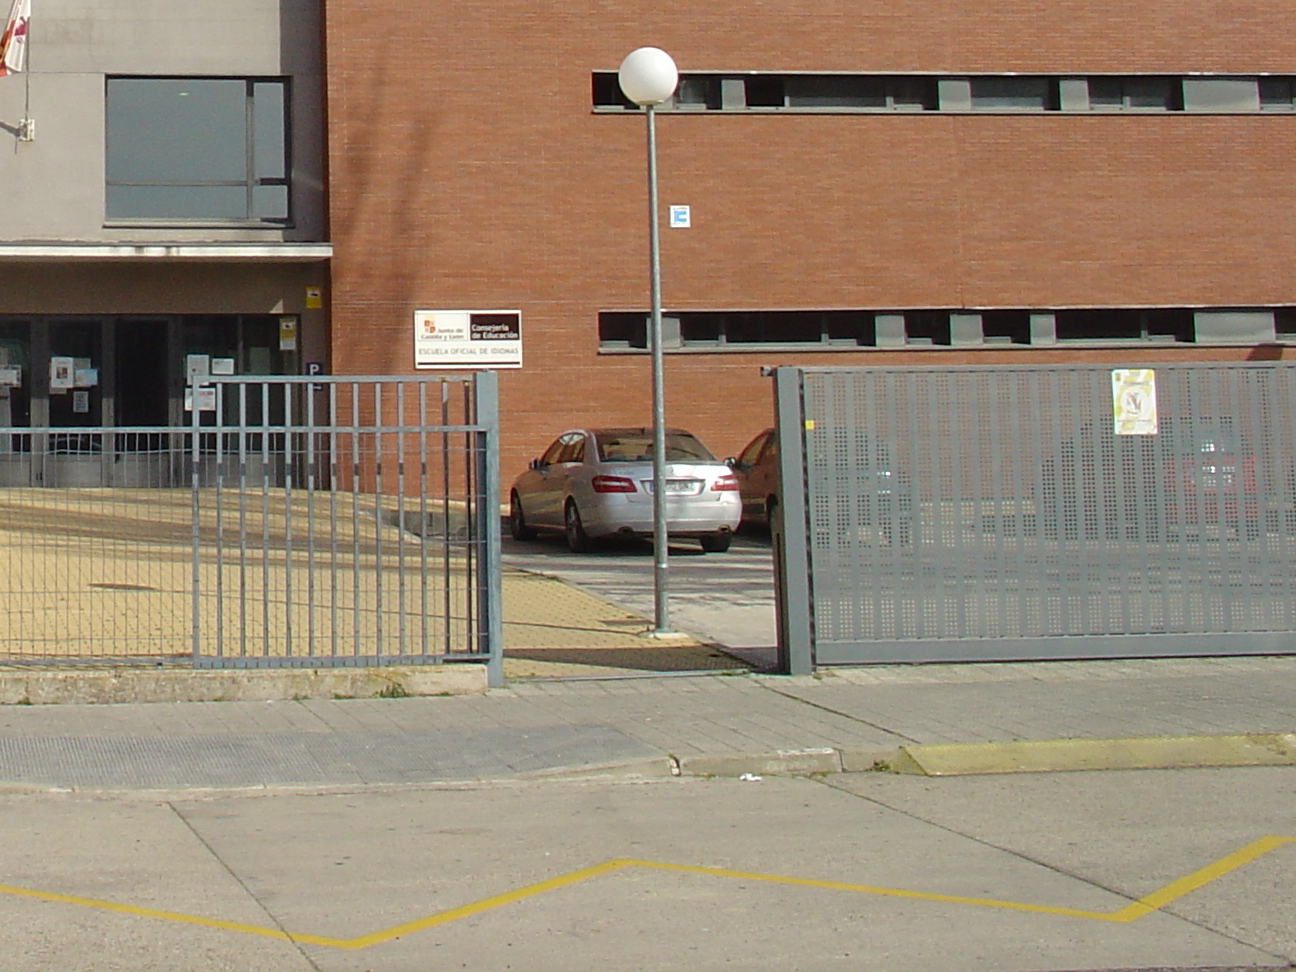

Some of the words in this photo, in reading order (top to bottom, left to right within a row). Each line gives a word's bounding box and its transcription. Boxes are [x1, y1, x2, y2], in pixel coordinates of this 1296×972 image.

[471, 323, 509, 333] Consejería
[482, 331, 519, 339] Educación
[418, 347, 449, 355] ESCUELA
[450, 347, 477, 355] OFICIAL
[479, 347, 488, 355] DE
[490, 347, 519, 355] IDIOMAS
